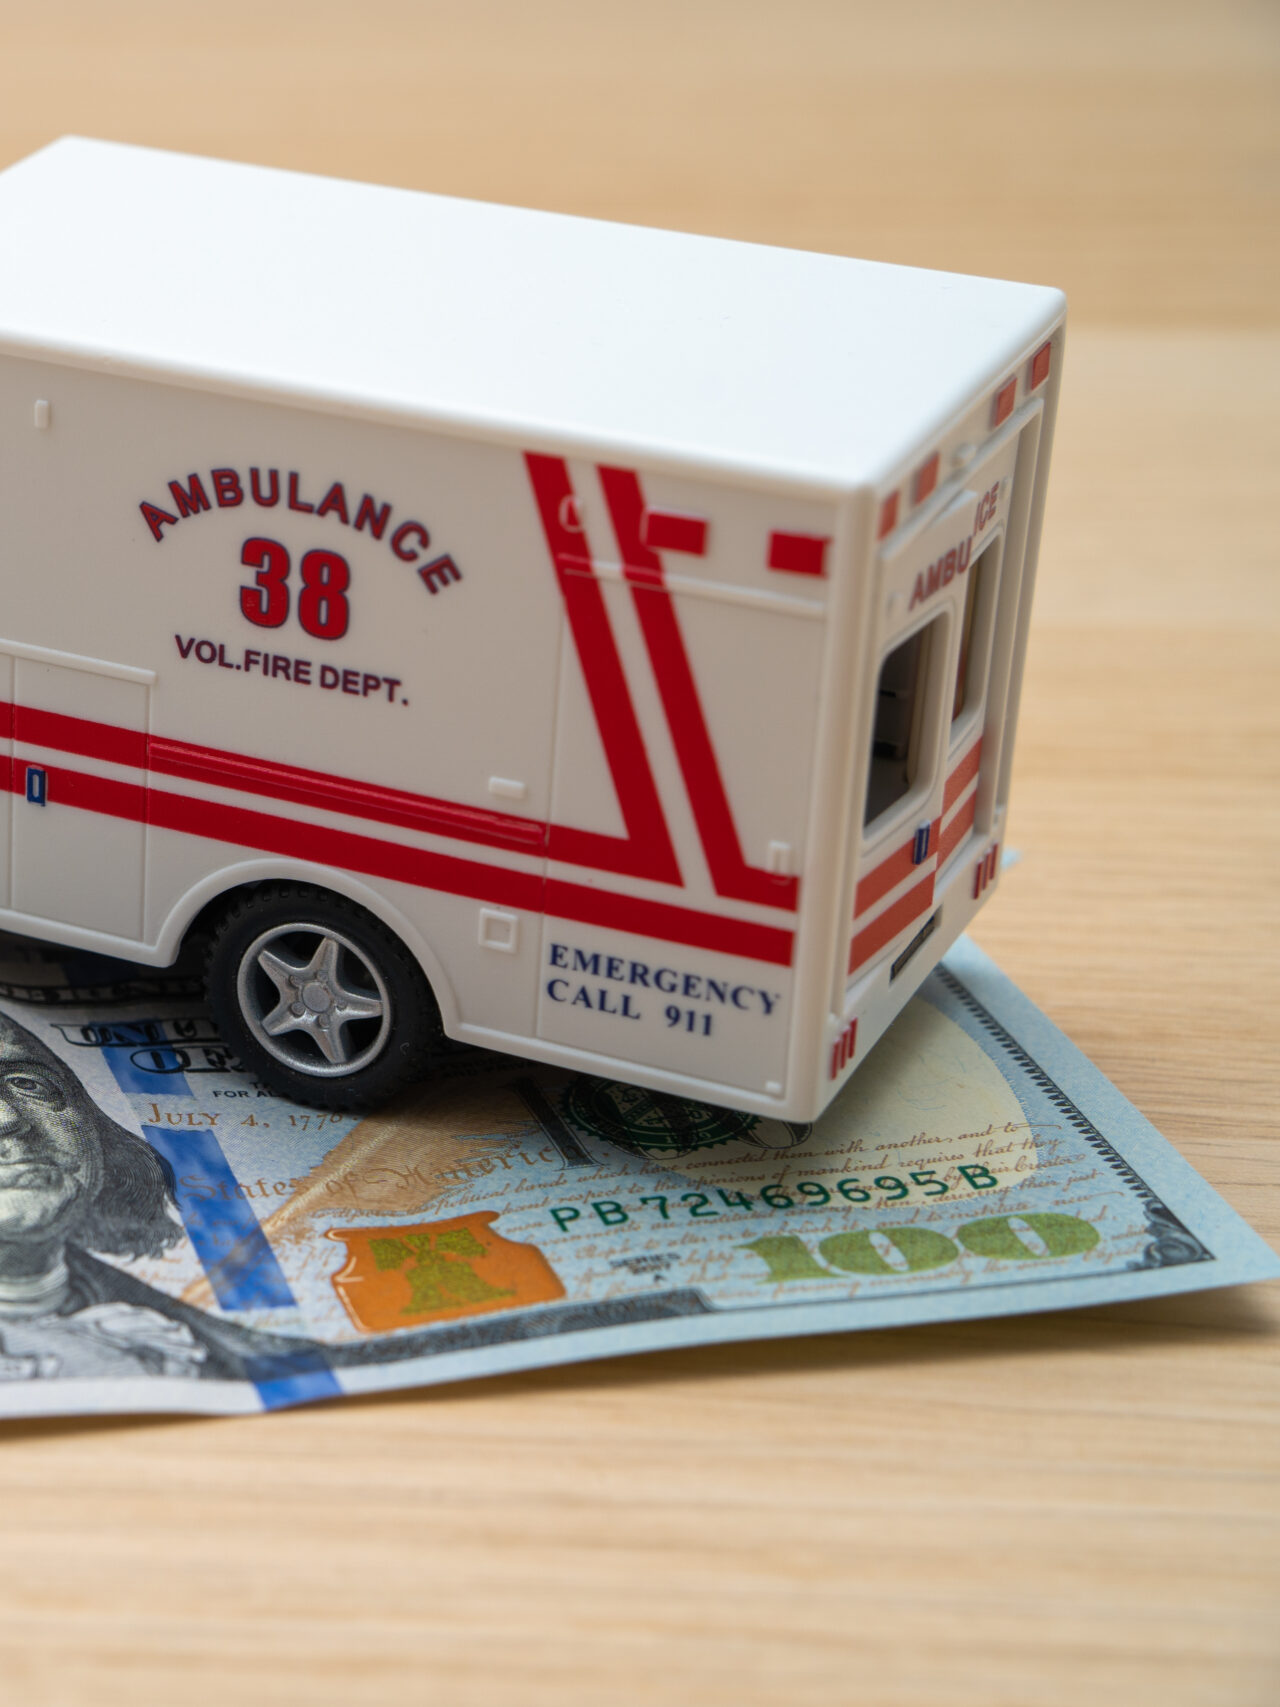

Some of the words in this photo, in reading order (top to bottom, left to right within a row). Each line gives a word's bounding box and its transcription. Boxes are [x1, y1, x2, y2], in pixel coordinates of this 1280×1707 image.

[139, 467, 462, 595] AMBULANCE
[239, 536, 350, 641] 38
[320, 664, 409, 706] DEPT.
[546, 978, 642, 1020] CALL
[665, 1004, 713, 1037] 911
[548, 943, 781, 1015] EMERGENCY
[212, 1089, 250, 1099] FOR
[577, 1162, 630, 1183] which
[685, 1148, 767, 1171] connected
[773, 1146, 815, 1161] them
[823, 1138, 866, 1157] with
[958, 1123, 996, 1141] and
[797, 1154, 888, 1178] mankind
[898, 1151, 965, 1170] requires
[973, 1139, 1014, 1158] that
[731, 1211, 1101, 1285] 100
